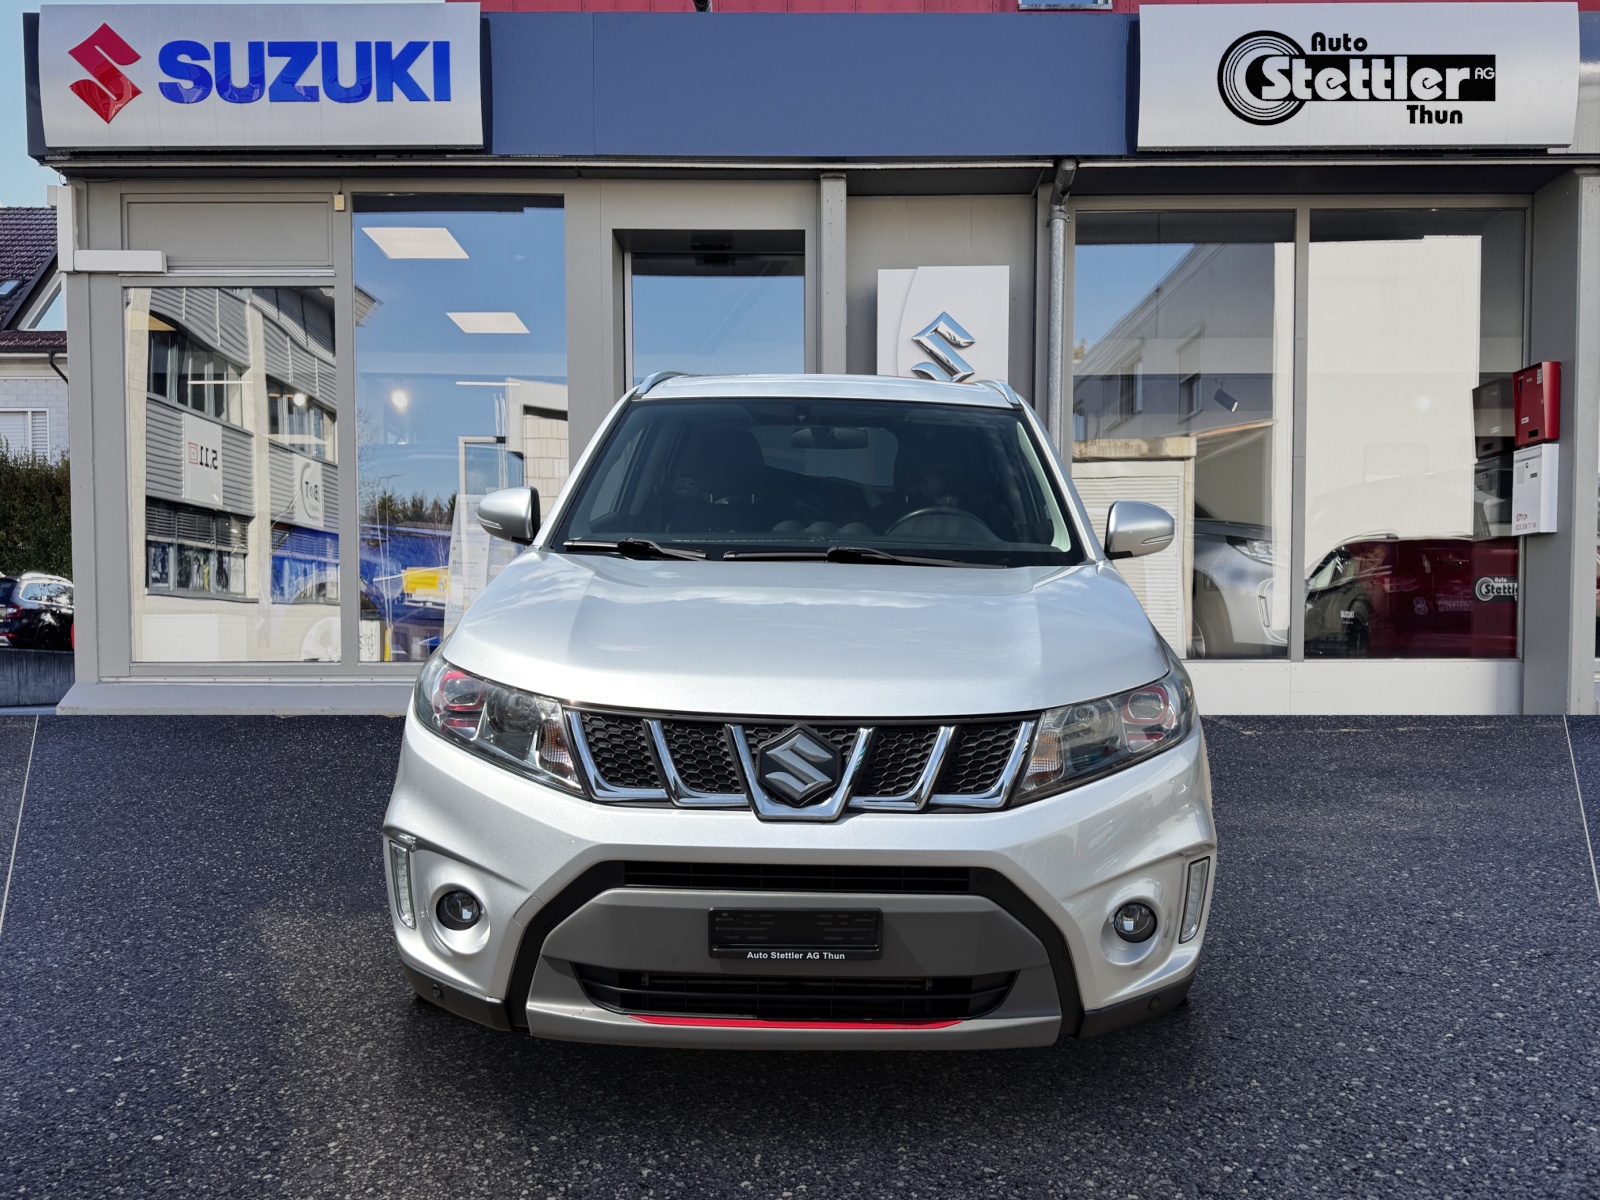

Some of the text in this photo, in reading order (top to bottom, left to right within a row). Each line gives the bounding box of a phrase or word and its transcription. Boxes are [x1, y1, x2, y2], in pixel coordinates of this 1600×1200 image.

[1310, 32, 1368, 52] Auto
[158, 40, 452, 104] SUZUKI
[1261, 55, 1495, 101] Stettler AG
[1406, 104, 1463, 125] Thun
[746, 951, 846, 960] Auto Stettler AG Thun
